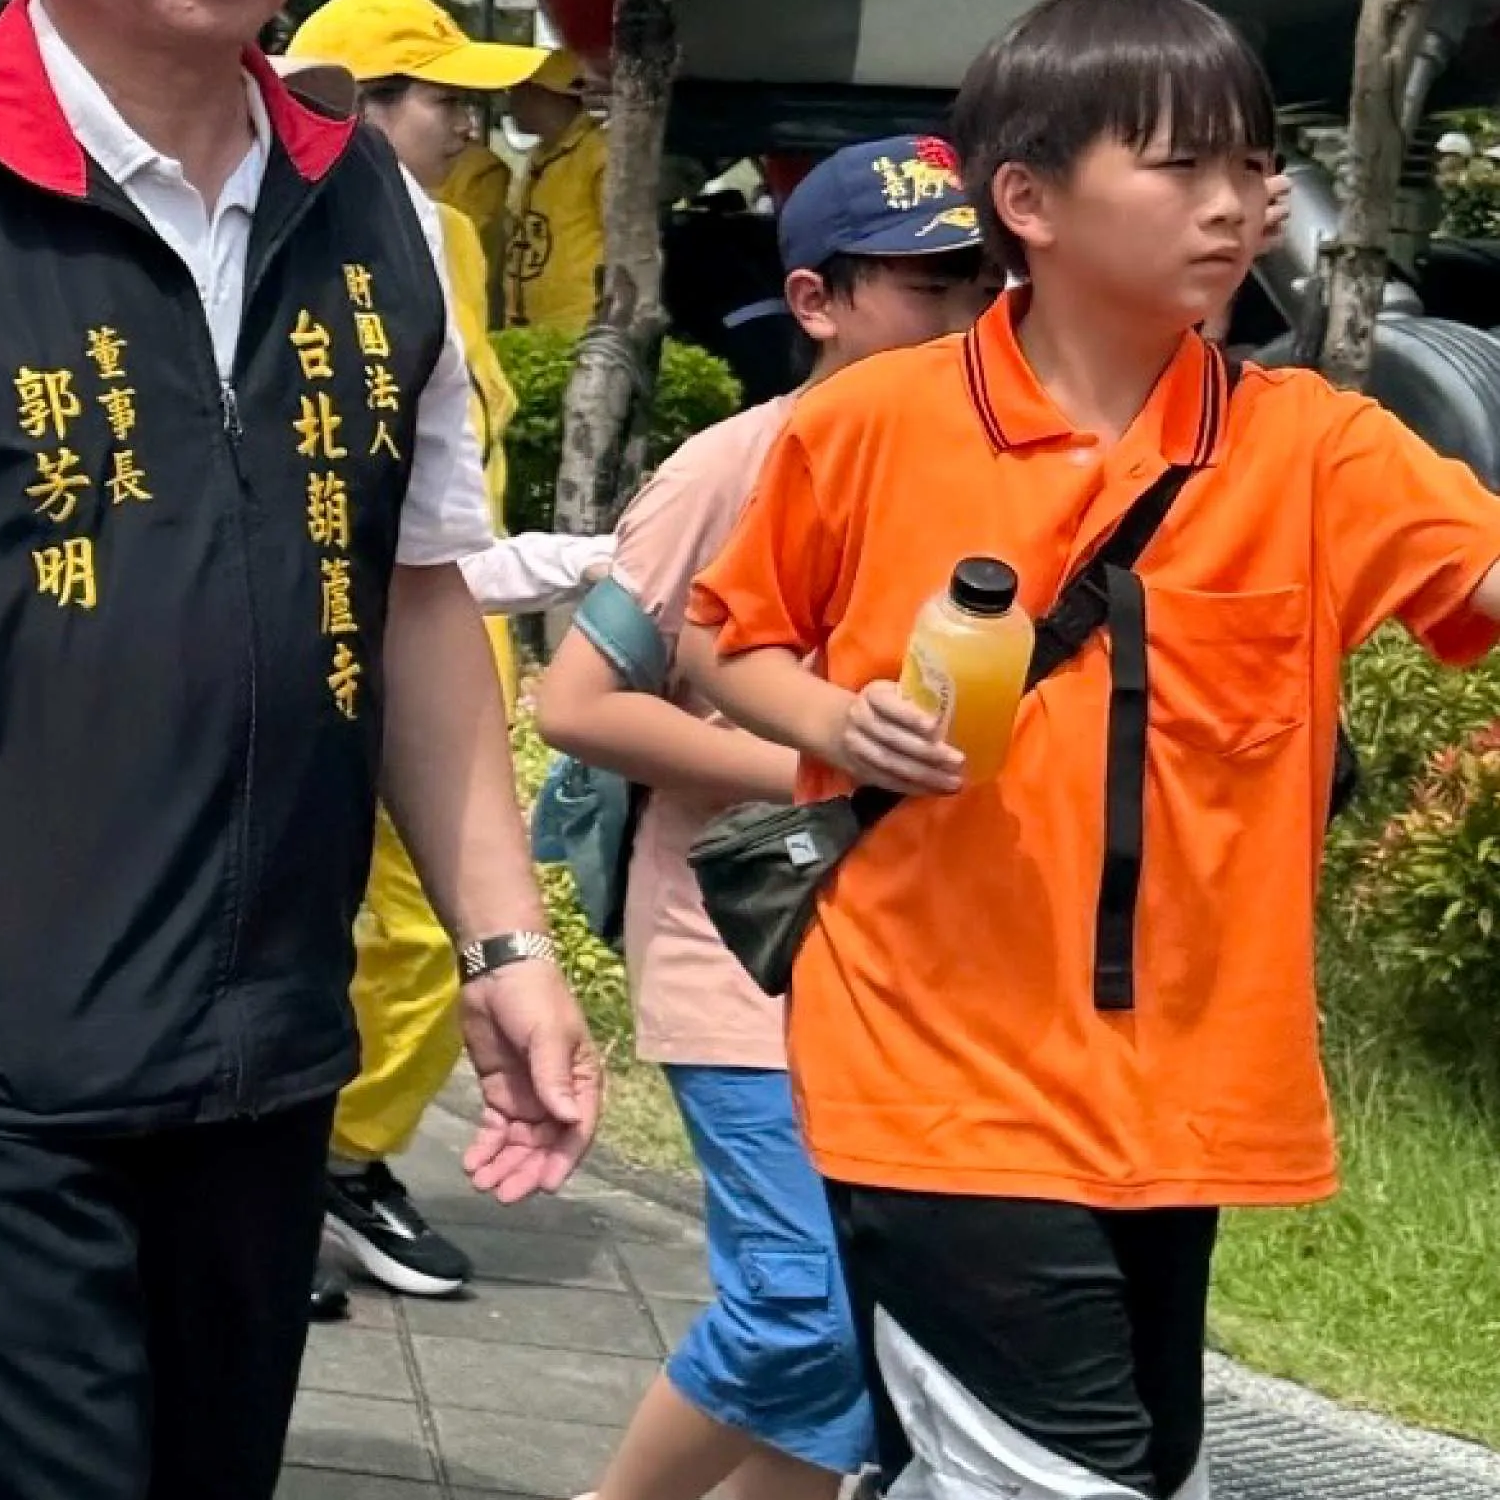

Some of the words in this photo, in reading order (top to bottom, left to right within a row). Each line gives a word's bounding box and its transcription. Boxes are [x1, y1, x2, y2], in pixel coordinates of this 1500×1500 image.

[86, 325, 153, 505] 董事長
[343, 263, 401, 460] 財團法人
[13, 366, 97, 610] 郭芳明
[290, 309, 364, 721] 台北葫蘆寺
